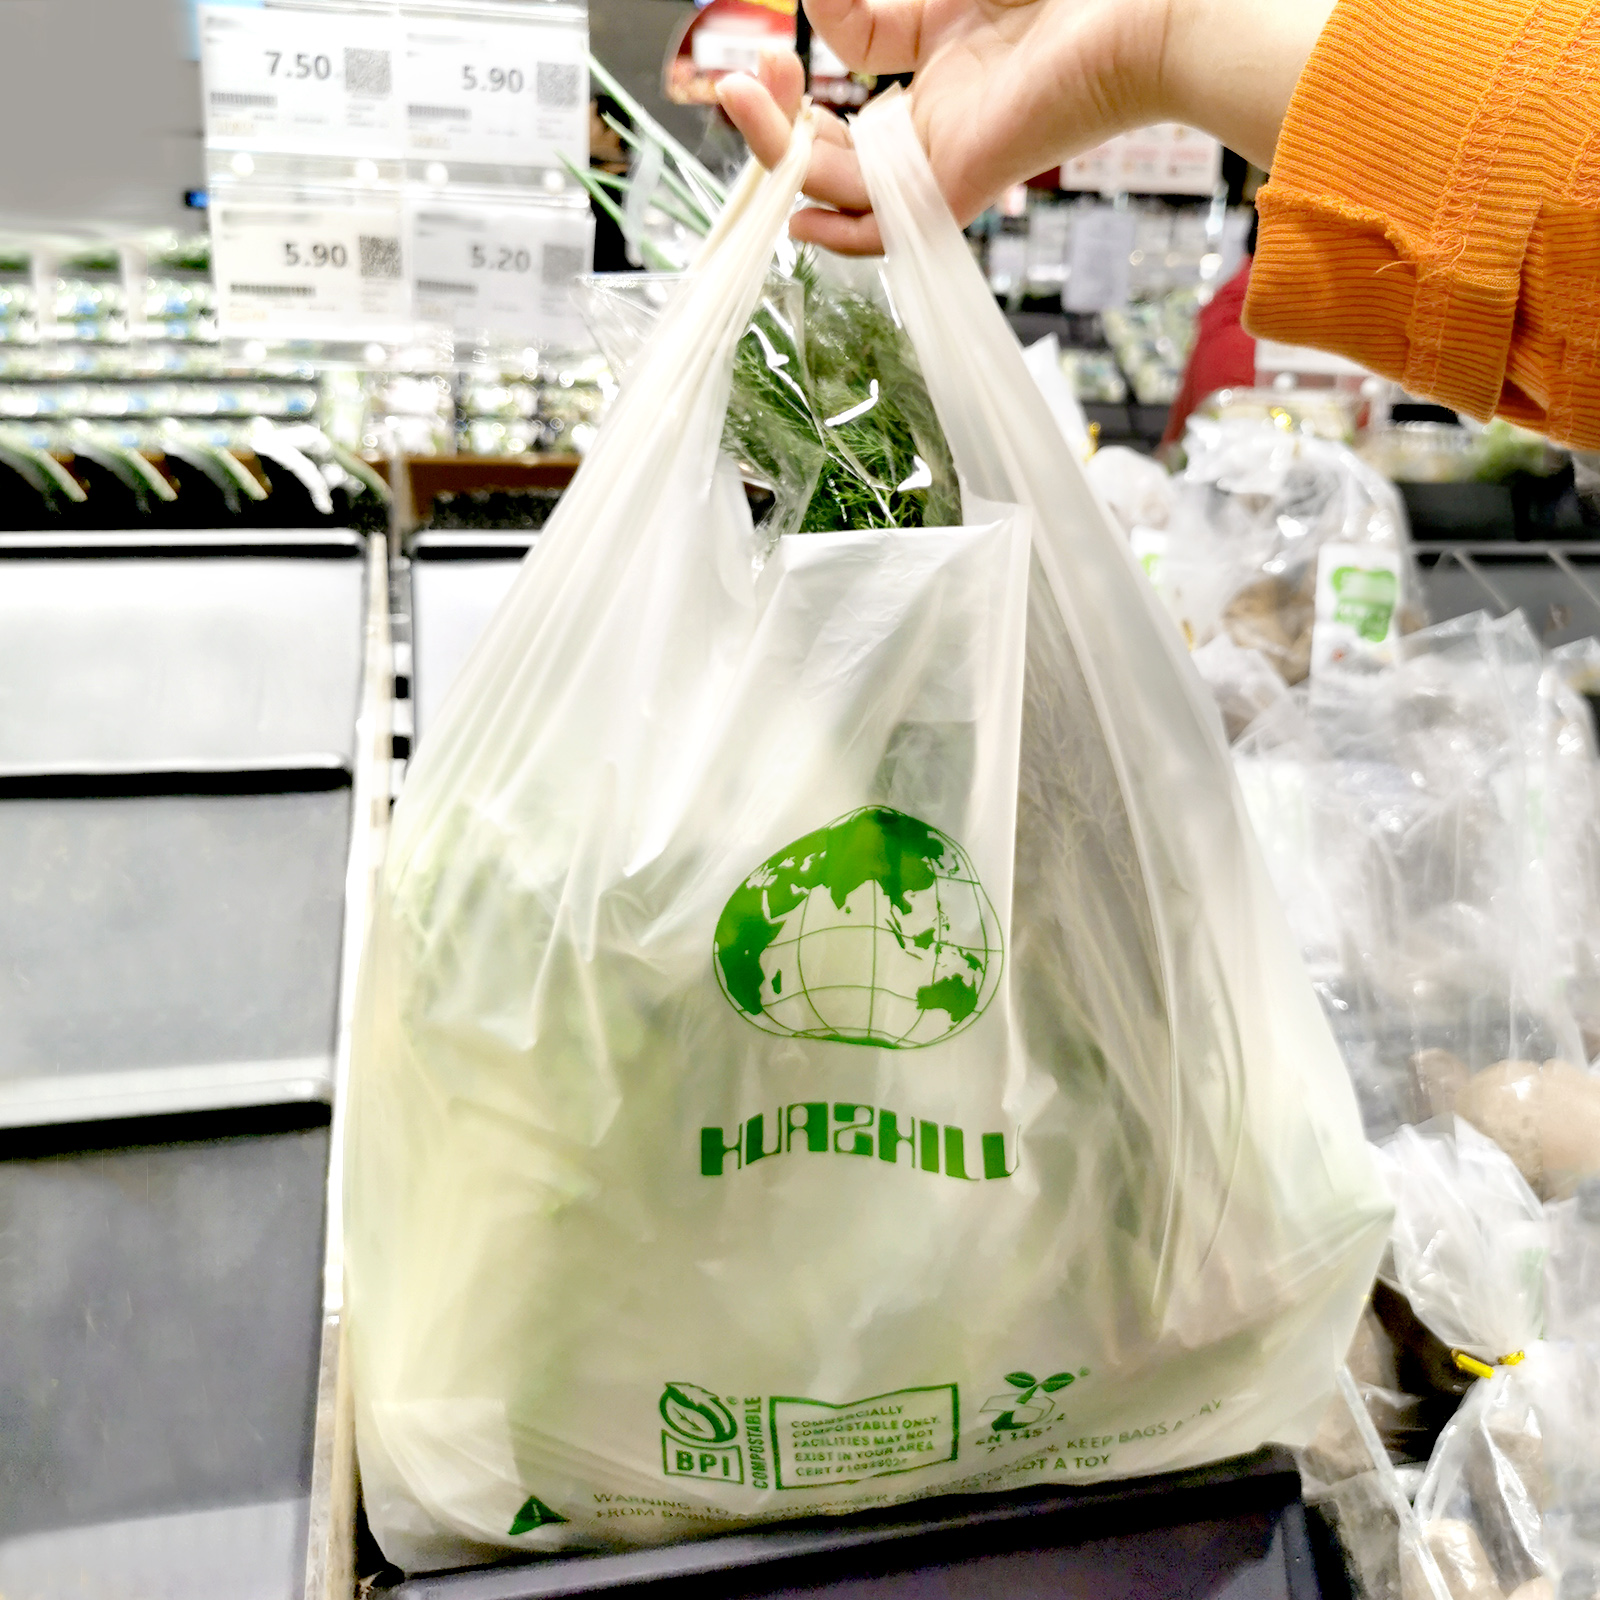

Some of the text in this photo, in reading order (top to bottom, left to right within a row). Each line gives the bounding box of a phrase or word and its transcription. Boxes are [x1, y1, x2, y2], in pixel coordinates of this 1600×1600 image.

[264, 51, 332, 80] 7.50
[461, 65, 525, 94] 5.90
[284, 242, 348, 268] 5.90
[471, 244, 531, 273] 5.20
[744, 1396, 769, 1490] COMPOSTABLE
[793, 1428, 934, 1448] FACILITIES MAY NOT
[1066, 1435, 1115, 1450] KEEP
[1119, 1422, 1168, 1443] BAGS
[675, 1449, 730, 1477] BPI
[794, 1452, 833, 1462] EXIST
[838, 1452, 852, 1462] IN
[896, 1440, 935, 1453] AREA
[1053, 1457, 1068, 1470] A
[1073, 1453, 1112, 1470] TOY
[795, 1466, 831, 1477] CERT
